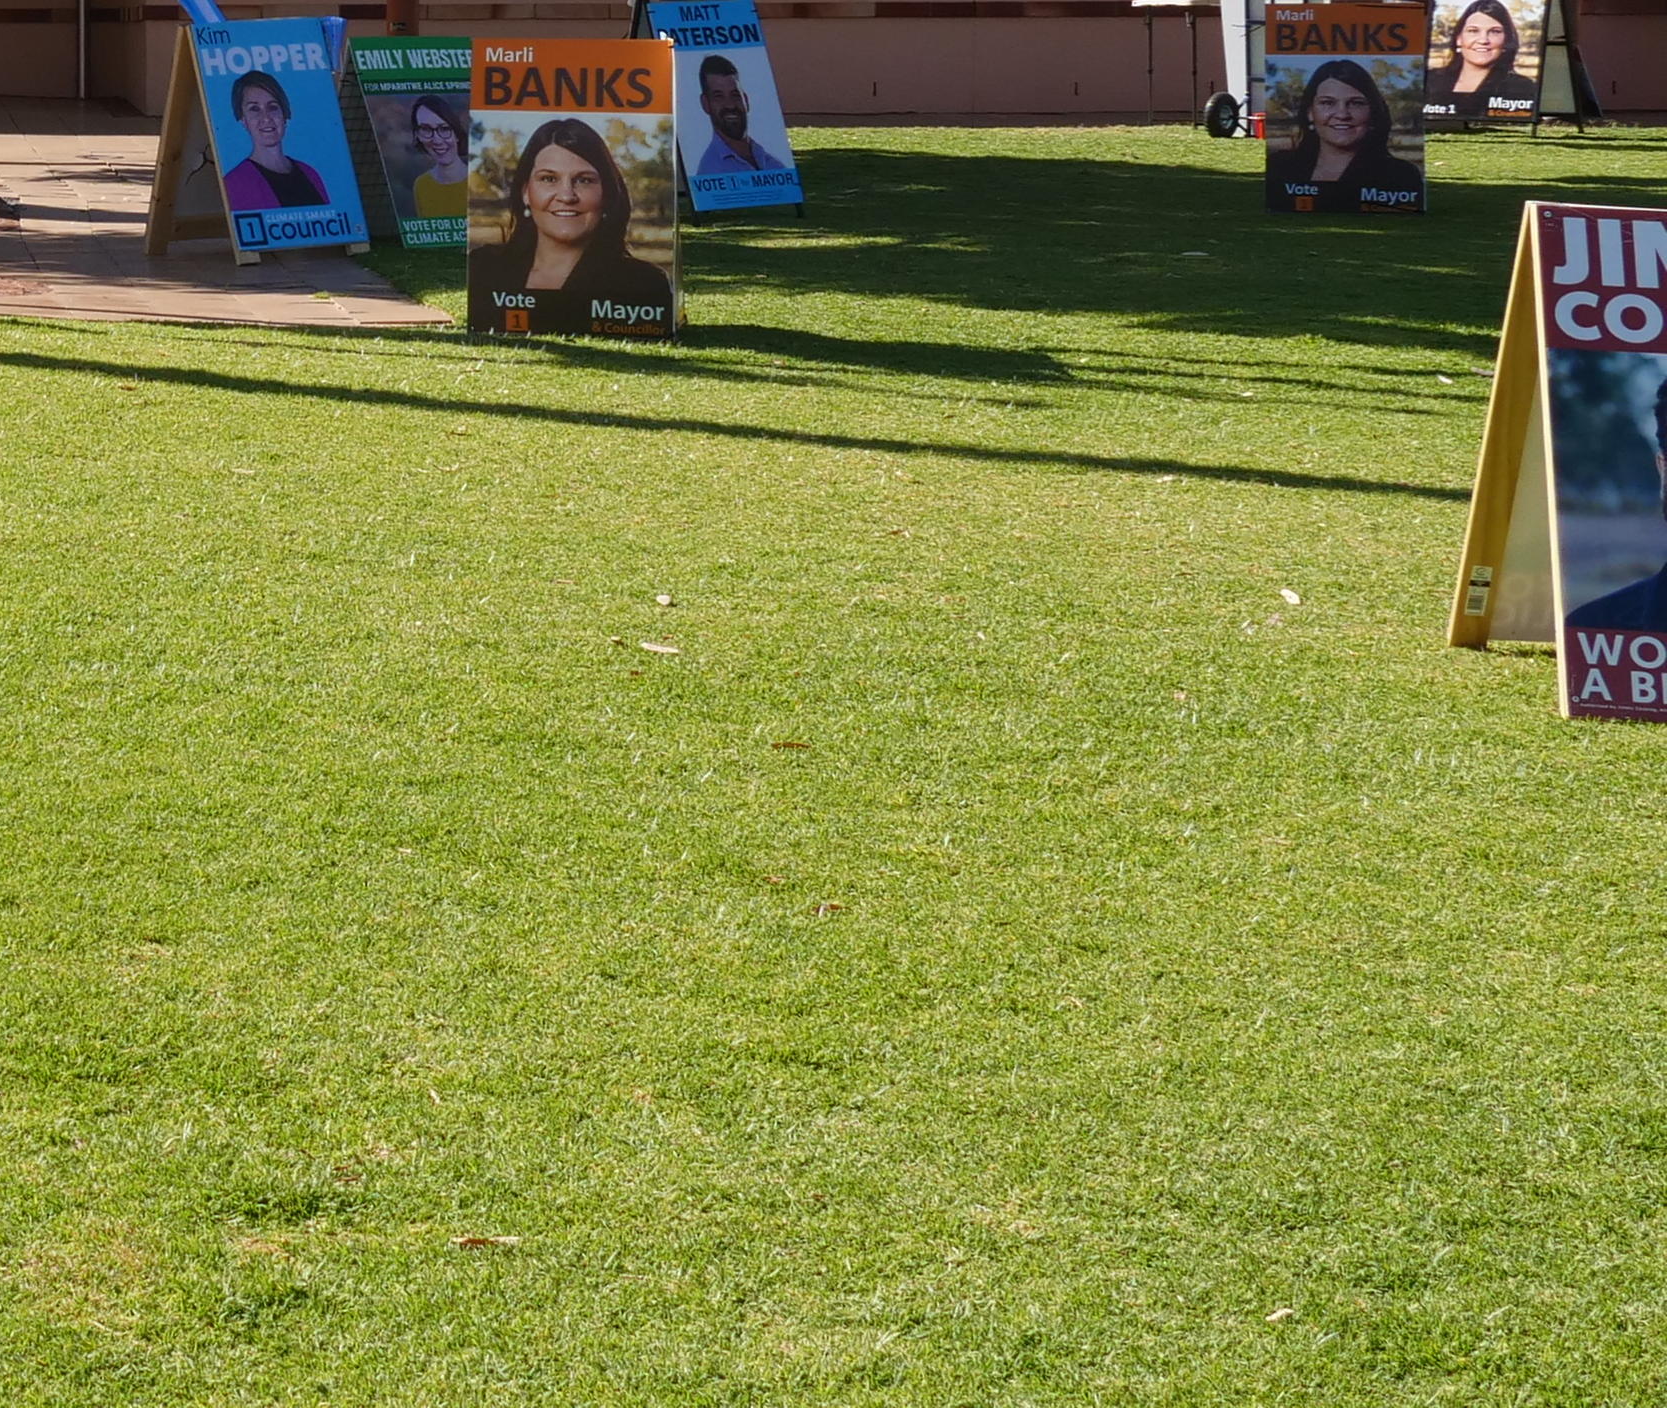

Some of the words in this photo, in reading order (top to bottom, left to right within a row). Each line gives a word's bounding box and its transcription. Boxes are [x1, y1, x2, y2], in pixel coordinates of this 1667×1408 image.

[678, 4, 720, 22] MATT
[1275, 10, 1314, 21] Marli
[196, 27, 231, 45] Kim
[1275, 23, 1409, 52] BANKS
[201, 43, 328, 76] HOPPER
[355, 49, 404, 70] EMILY
[485, 47, 533, 62] Marli
[364, 83, 378, 91] FOR
[423, 82, 445, 90] ALICE
[484, 67, 653, 108] BANKS
[1447, 104, 1455, 114] 1
[1488, 96, 1533, 110] Mayor
[694, 178, 726, 192] VOTE
[751, 173, 793, 187] MAYOR
[1285, 183, 1319, 195] Vote
[1360, 188, 1417, 205] Mayor
[267, 213, 304, 223] CLIMATE
[306, 210, 336, 220] SMART
[268, 212, 351, 241] council
[403, 220, 430, 233] VOTE
[432, 219, 451, 231] FOR
[405, 231, 446, 244] CLIMATE
[492, 291, 536, 308] Vote
[591, 299, 665, 324] Mayor
[605, 321, 667, 336] Councillor
[1581, 668, 1613, 701] A
